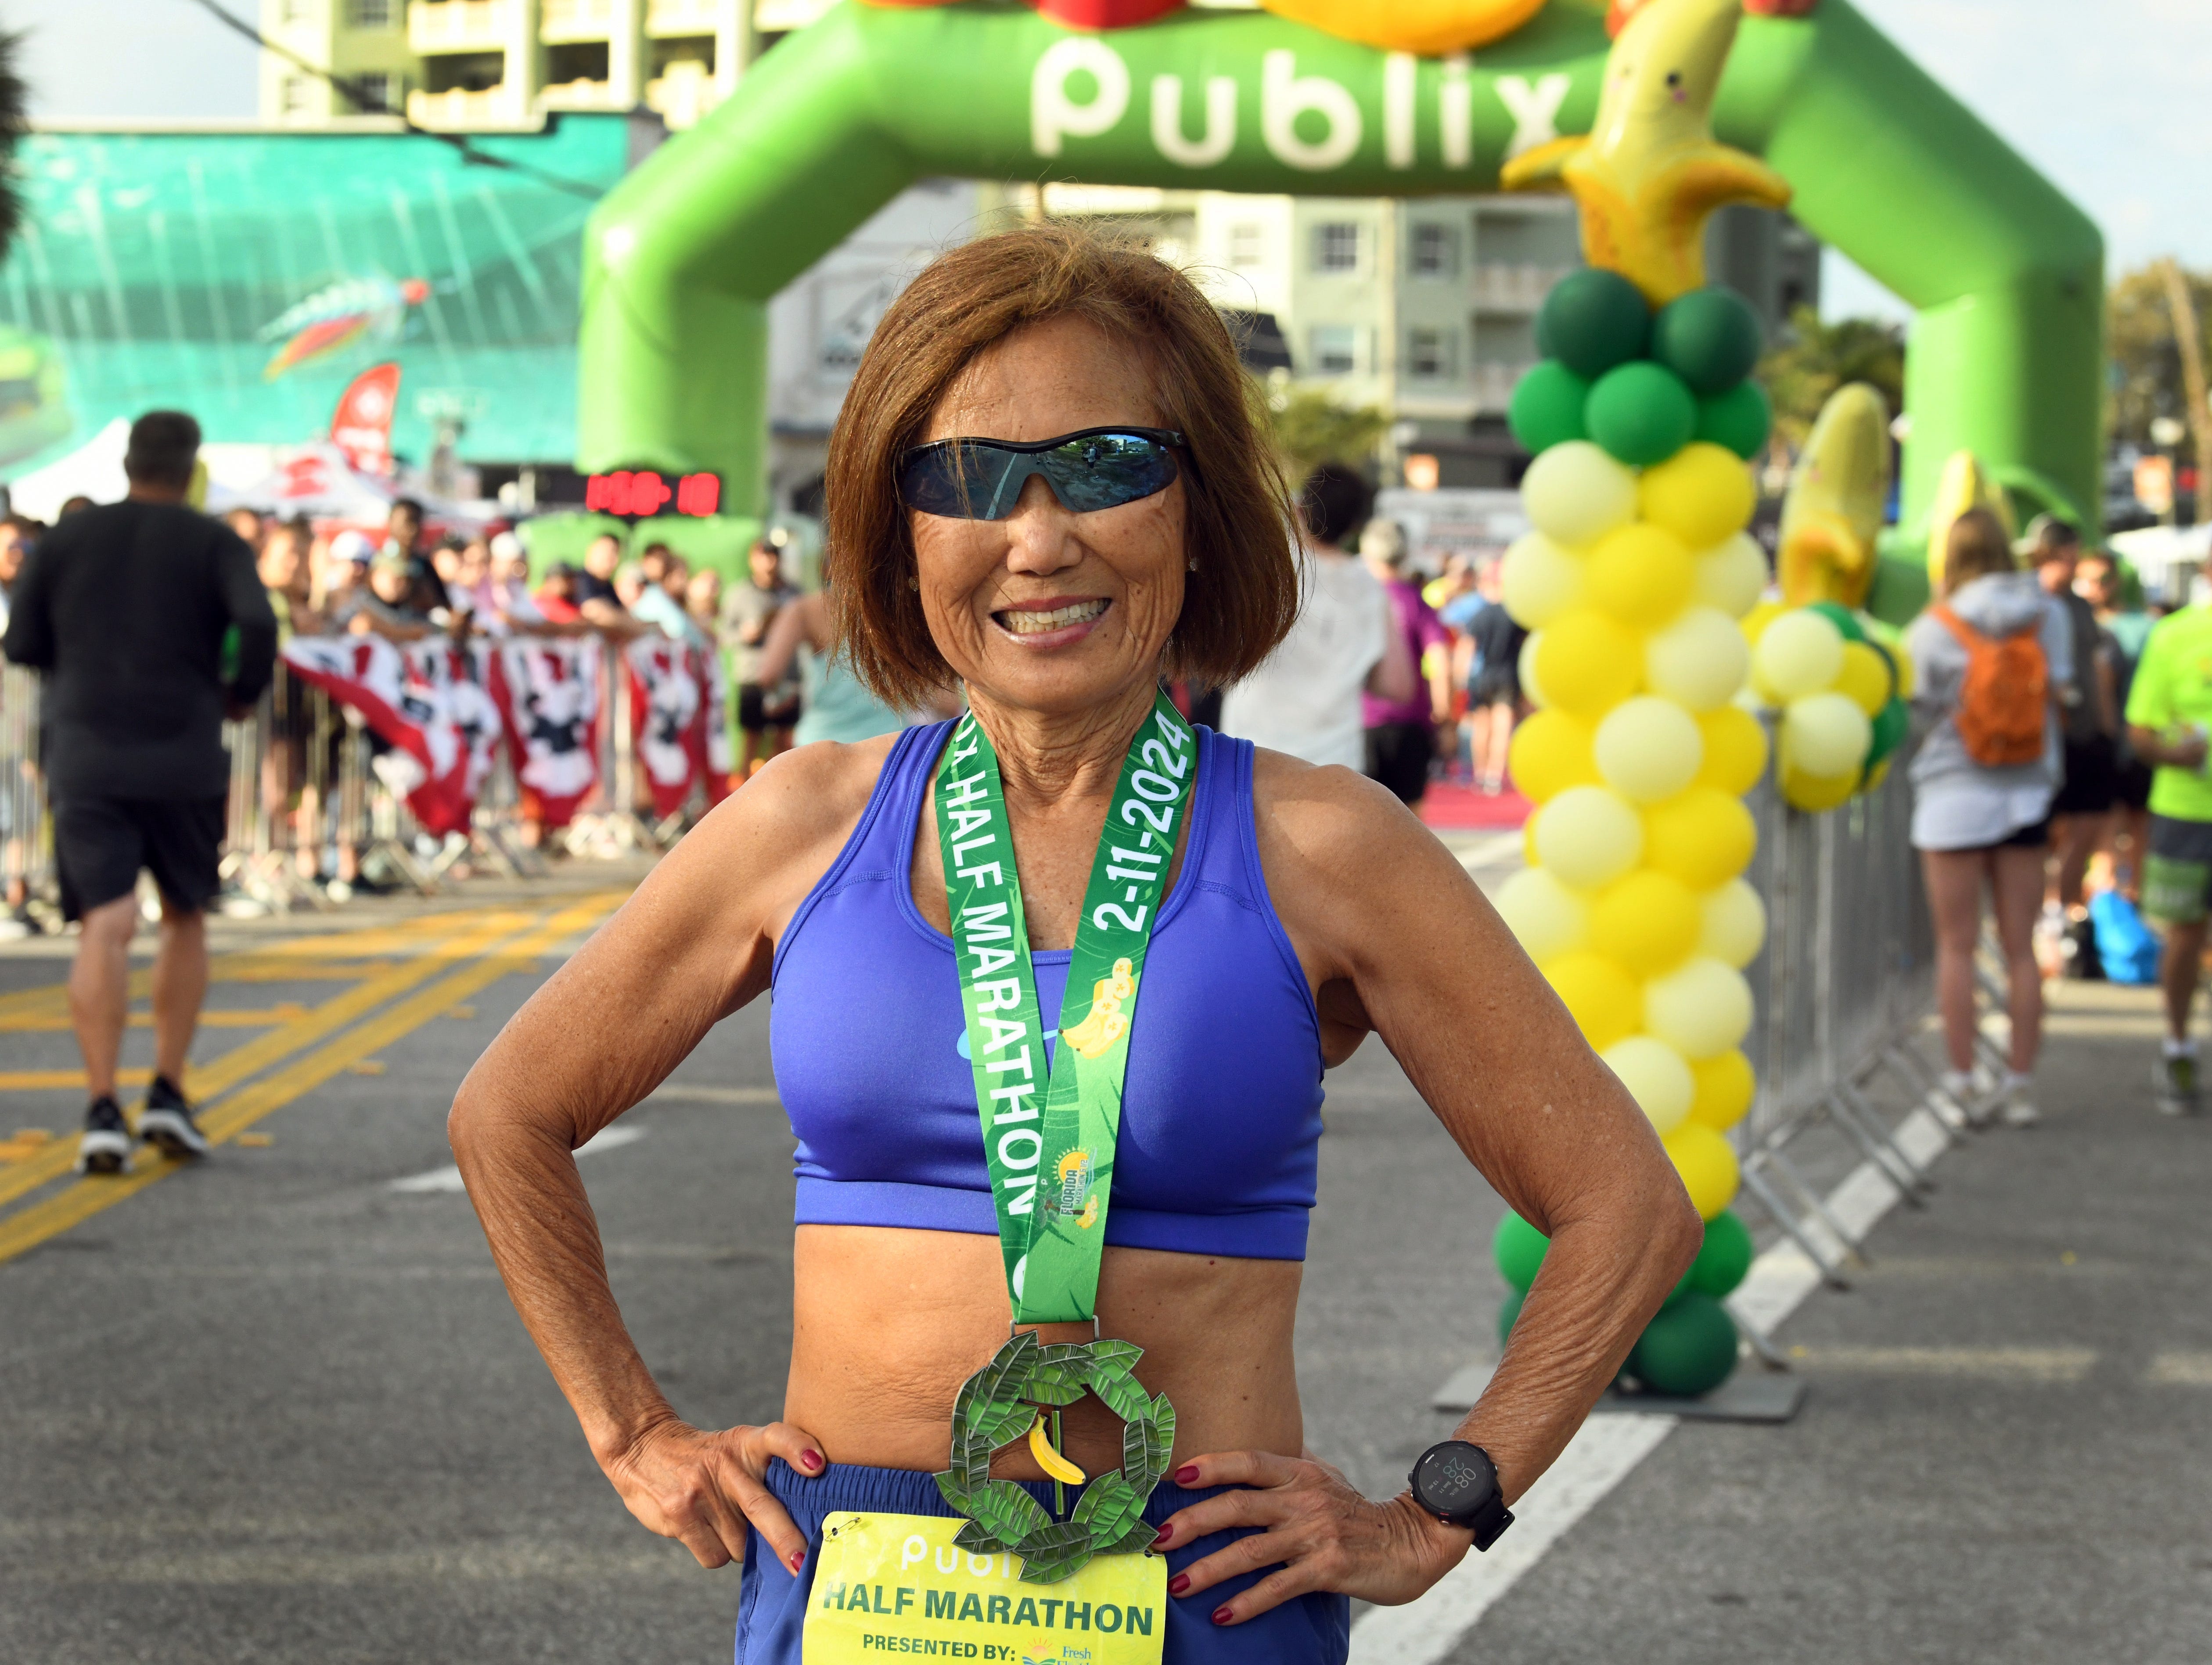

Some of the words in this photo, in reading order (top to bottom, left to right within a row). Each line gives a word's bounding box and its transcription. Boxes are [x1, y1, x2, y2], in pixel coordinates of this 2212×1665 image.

[1029, 36, 1573, 172] Publix
[946, 770, 1003, 888] HALF
[1093, 709, 1190, 932] 2-11-2024
[962, 901, 1042, 1216] MARATHON
[1060, 1169, 1078, 1215] FLORIDA
[1075, 1173, 1086, 1205] MARATHON
[1443, 1457, 1464, 1478] 28
[1455, 1468, 1476, 1488] 08
[824, 1581, 916, 1616] HALF
[925, 1589, 1154, 1636] MARATHON
[863, 1633, 978, 1658] PRESENTED
[983, 1643, 1016, 1662] BY:
[1062, 1646, 1092, 1660] Fresh
